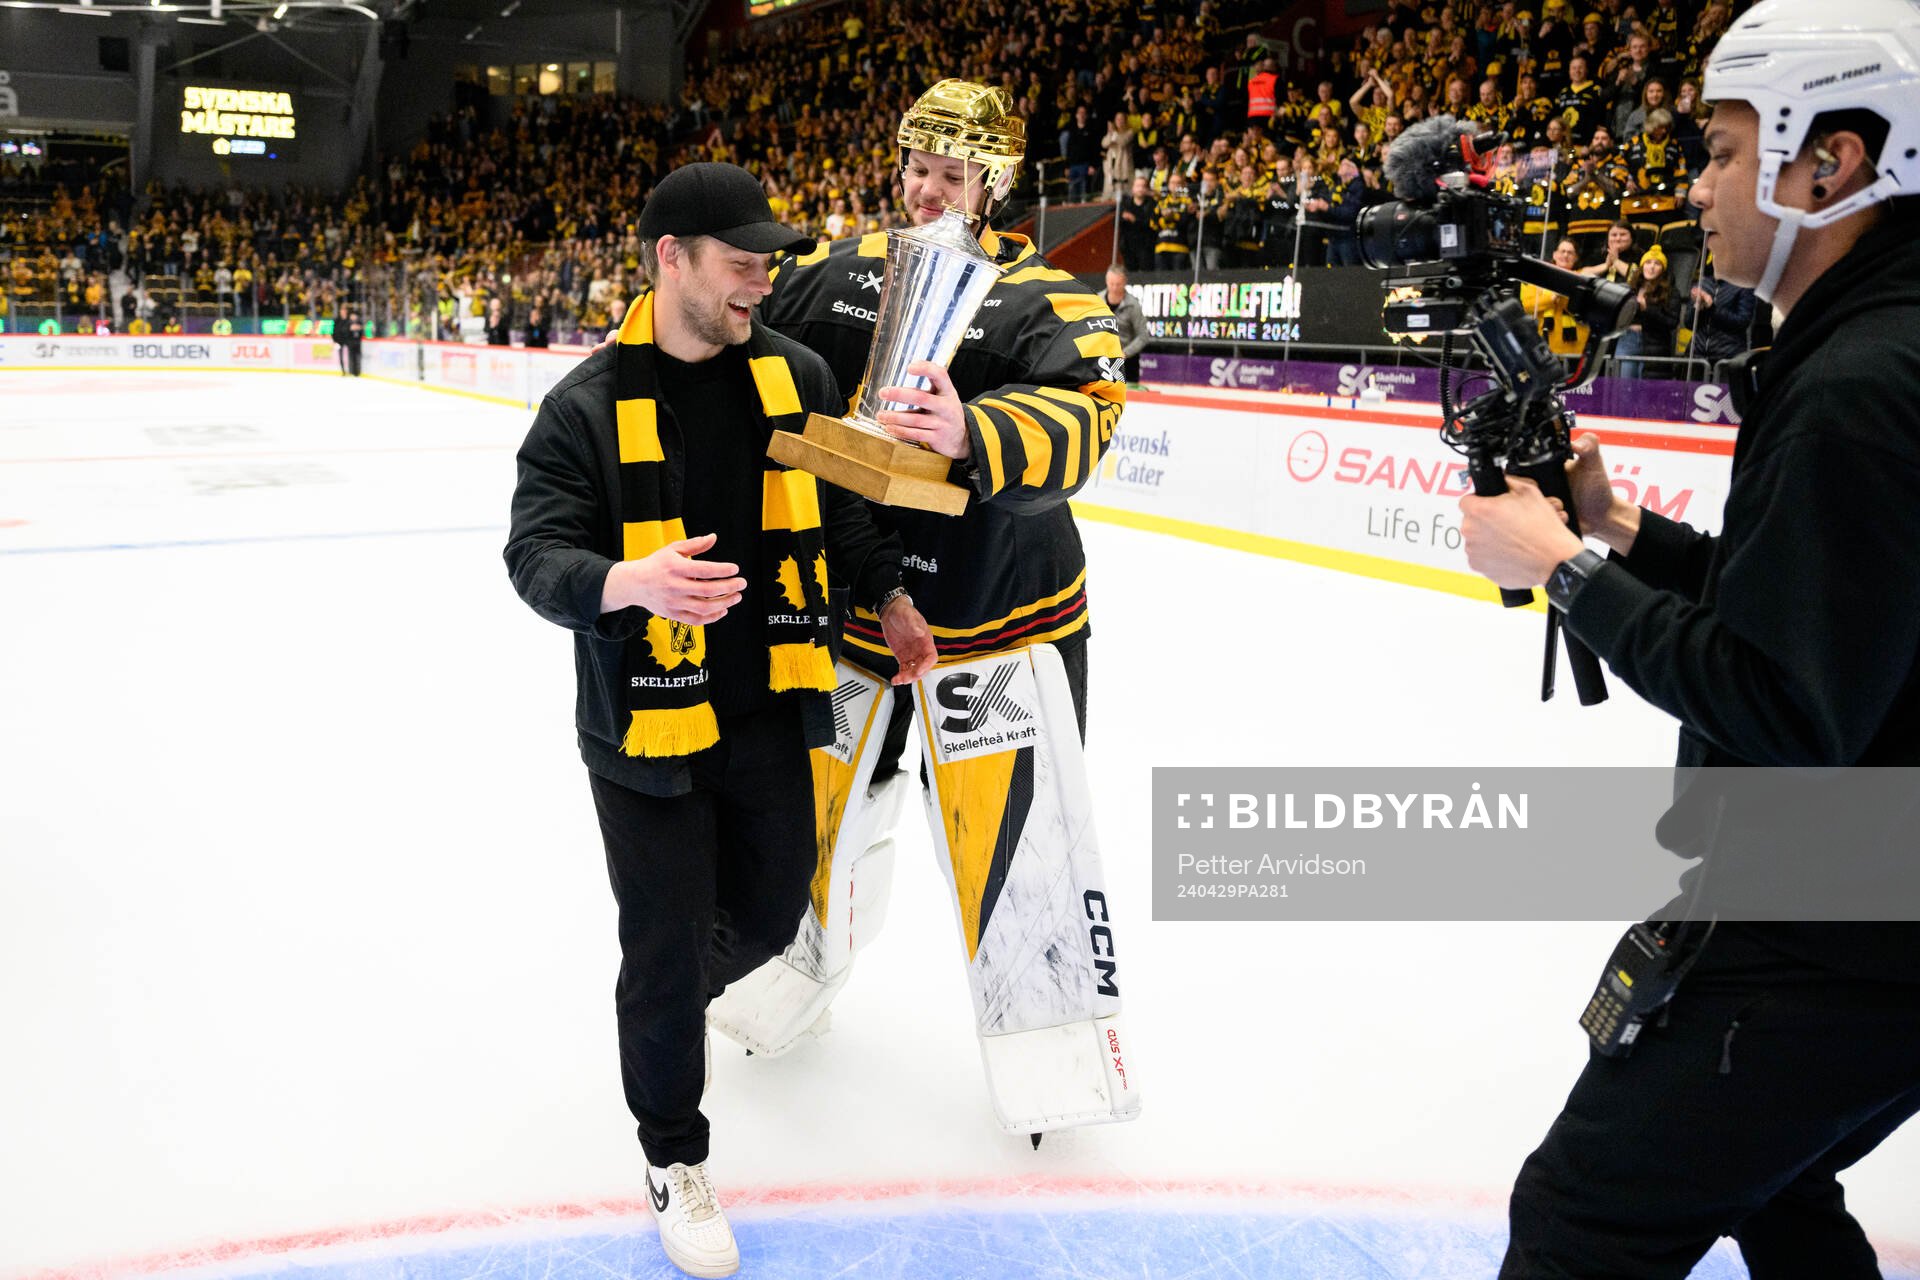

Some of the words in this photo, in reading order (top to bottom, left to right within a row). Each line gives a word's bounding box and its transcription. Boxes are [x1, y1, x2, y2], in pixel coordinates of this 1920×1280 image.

[184, 86, 293, 115] SVENSKA
[831, 300, 879, 322] ŠKOD
[983, 299, 1002, 307] on
[1125, 283, 1188, 317] RATTIS
[1086, 318, 1119, 333] HOL
[1146, 321, 1183, 337] NSKA
[1262, 322, 1300, 341] 2024
[132, 344, 211, 359] BOLIDEN
[231, 345, 271, 359] JULA
[1209, 357, 1240, 388] SK
[1336, 364, 1375, 397] SK
[1109, 426, 1170, 457] Svensk
[1116, 455, 1165, 487] Cater
[1367, 506, 1420, 544] Life
[1431, 513, 1462, 550] fo
[902, 554, 938, 573] efteå
[768, 614, 811, 625] SKELLE
[631, 668, 704, 688] SKELLEFTEÅ
[936, 661, 1033, 733] SK
[944, 732, 1004, 755] Skellefteå
[1006, 726, 1037, 742] Kraft
[1083, 889, 1119, 997] CCM
